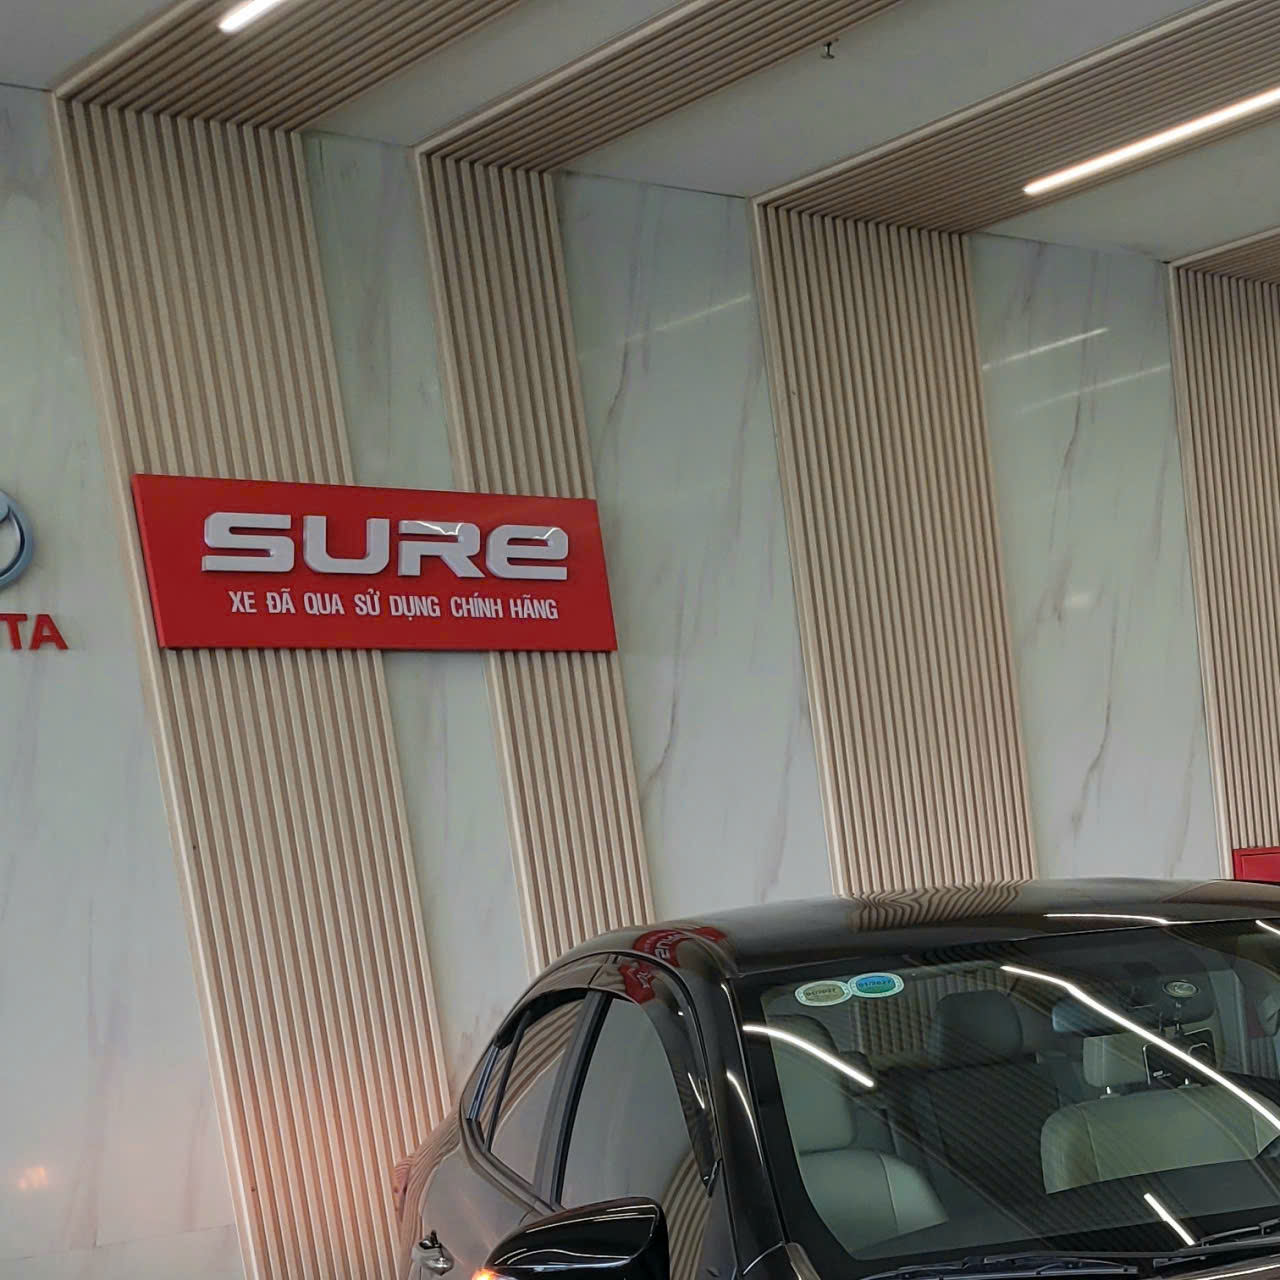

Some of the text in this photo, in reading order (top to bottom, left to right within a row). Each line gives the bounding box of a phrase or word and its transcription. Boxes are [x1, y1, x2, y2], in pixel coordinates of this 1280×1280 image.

[228, 587, 558, 621] XE ĐÃ QUA SỬ DỤNG CHÍNH HÃNG
